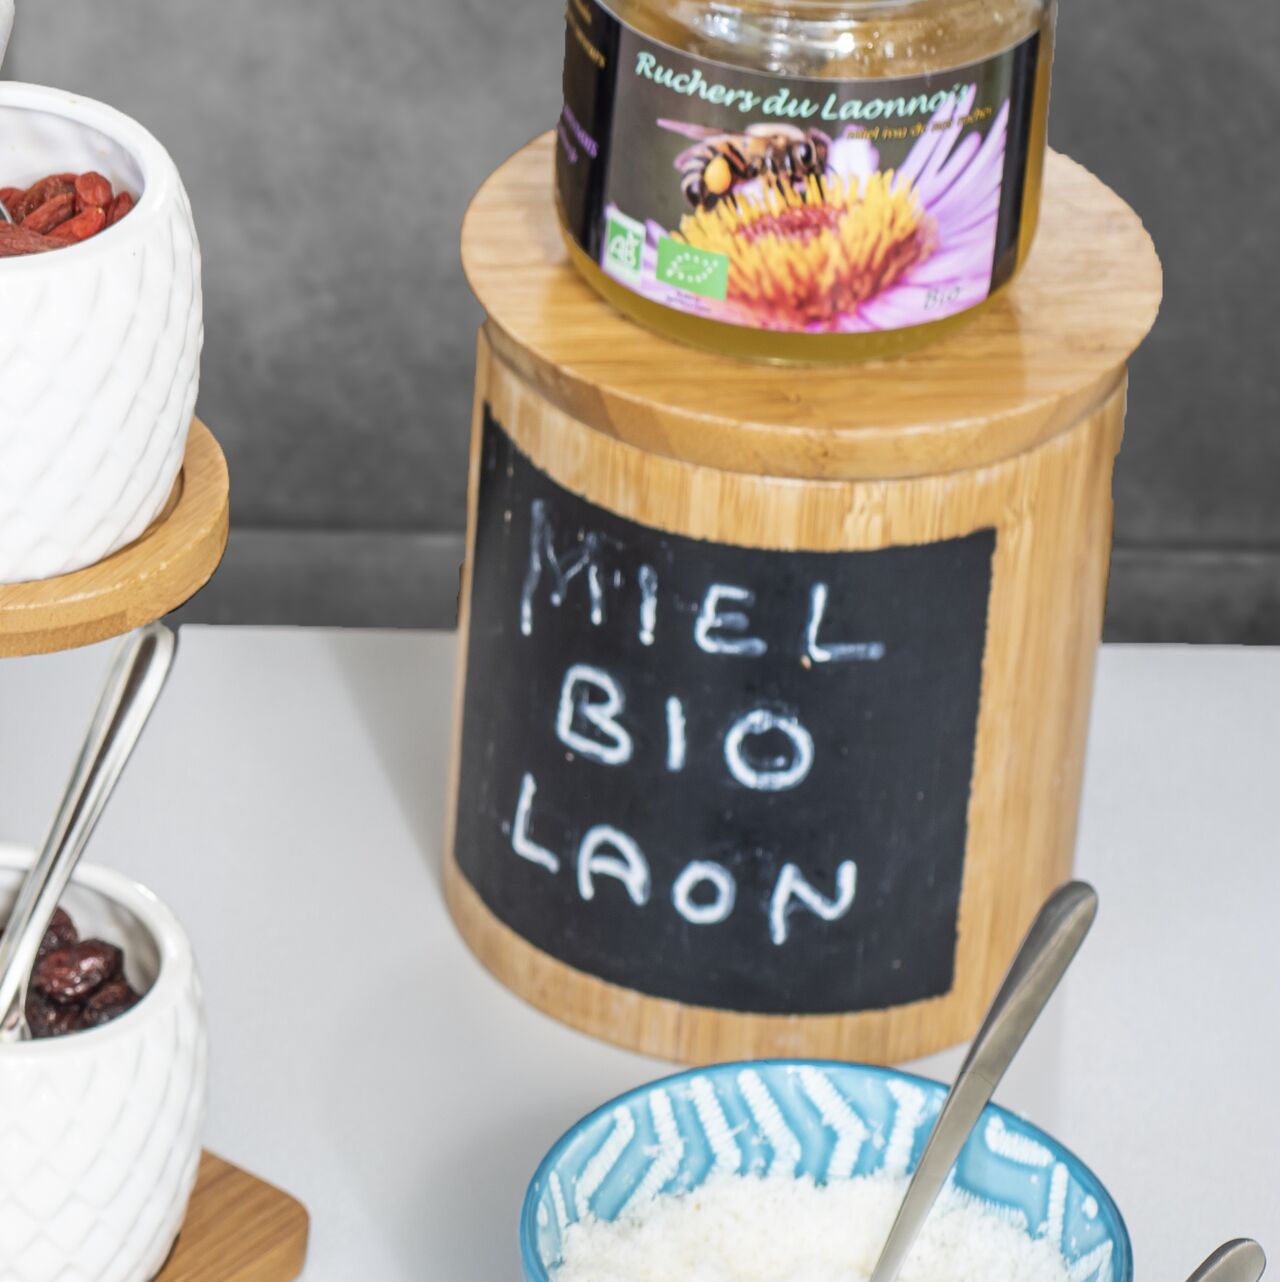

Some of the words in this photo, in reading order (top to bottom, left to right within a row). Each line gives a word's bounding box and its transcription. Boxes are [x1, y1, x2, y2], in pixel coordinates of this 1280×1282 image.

[633, 51, 762, 114] Ruchers
[762, 88, 819, 119] du
[520, 500, 885, 663] MIEL
[556, 664, 814, 791] BIO
[511, 772, 857, 945] LAON
